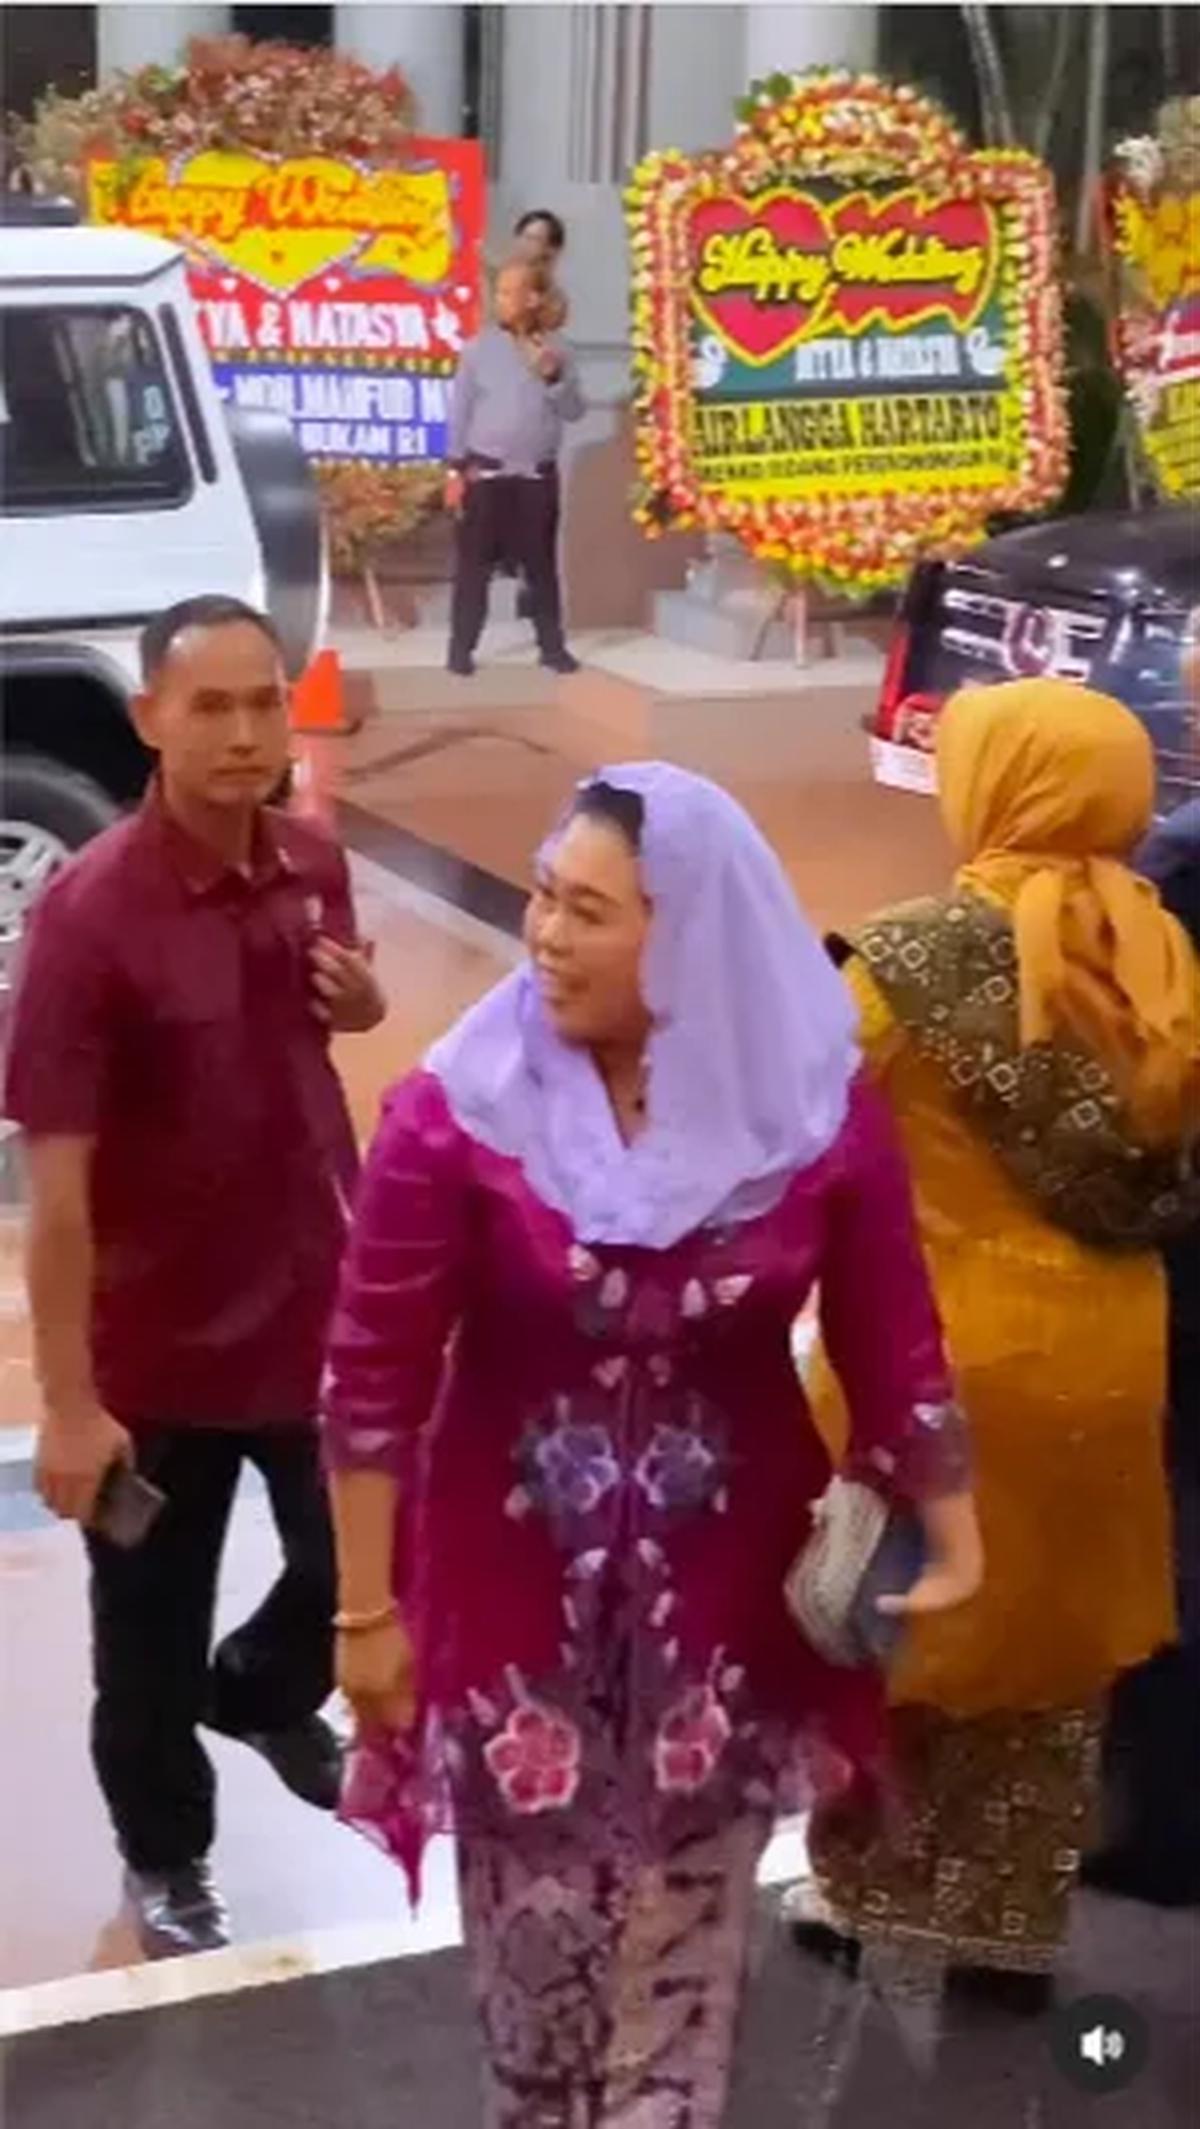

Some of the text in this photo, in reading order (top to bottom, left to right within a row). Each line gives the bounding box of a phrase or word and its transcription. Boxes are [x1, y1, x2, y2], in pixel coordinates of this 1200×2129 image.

[700, 227, 983, 300] Happy Wedding
[256, 301, 283, 347] &
